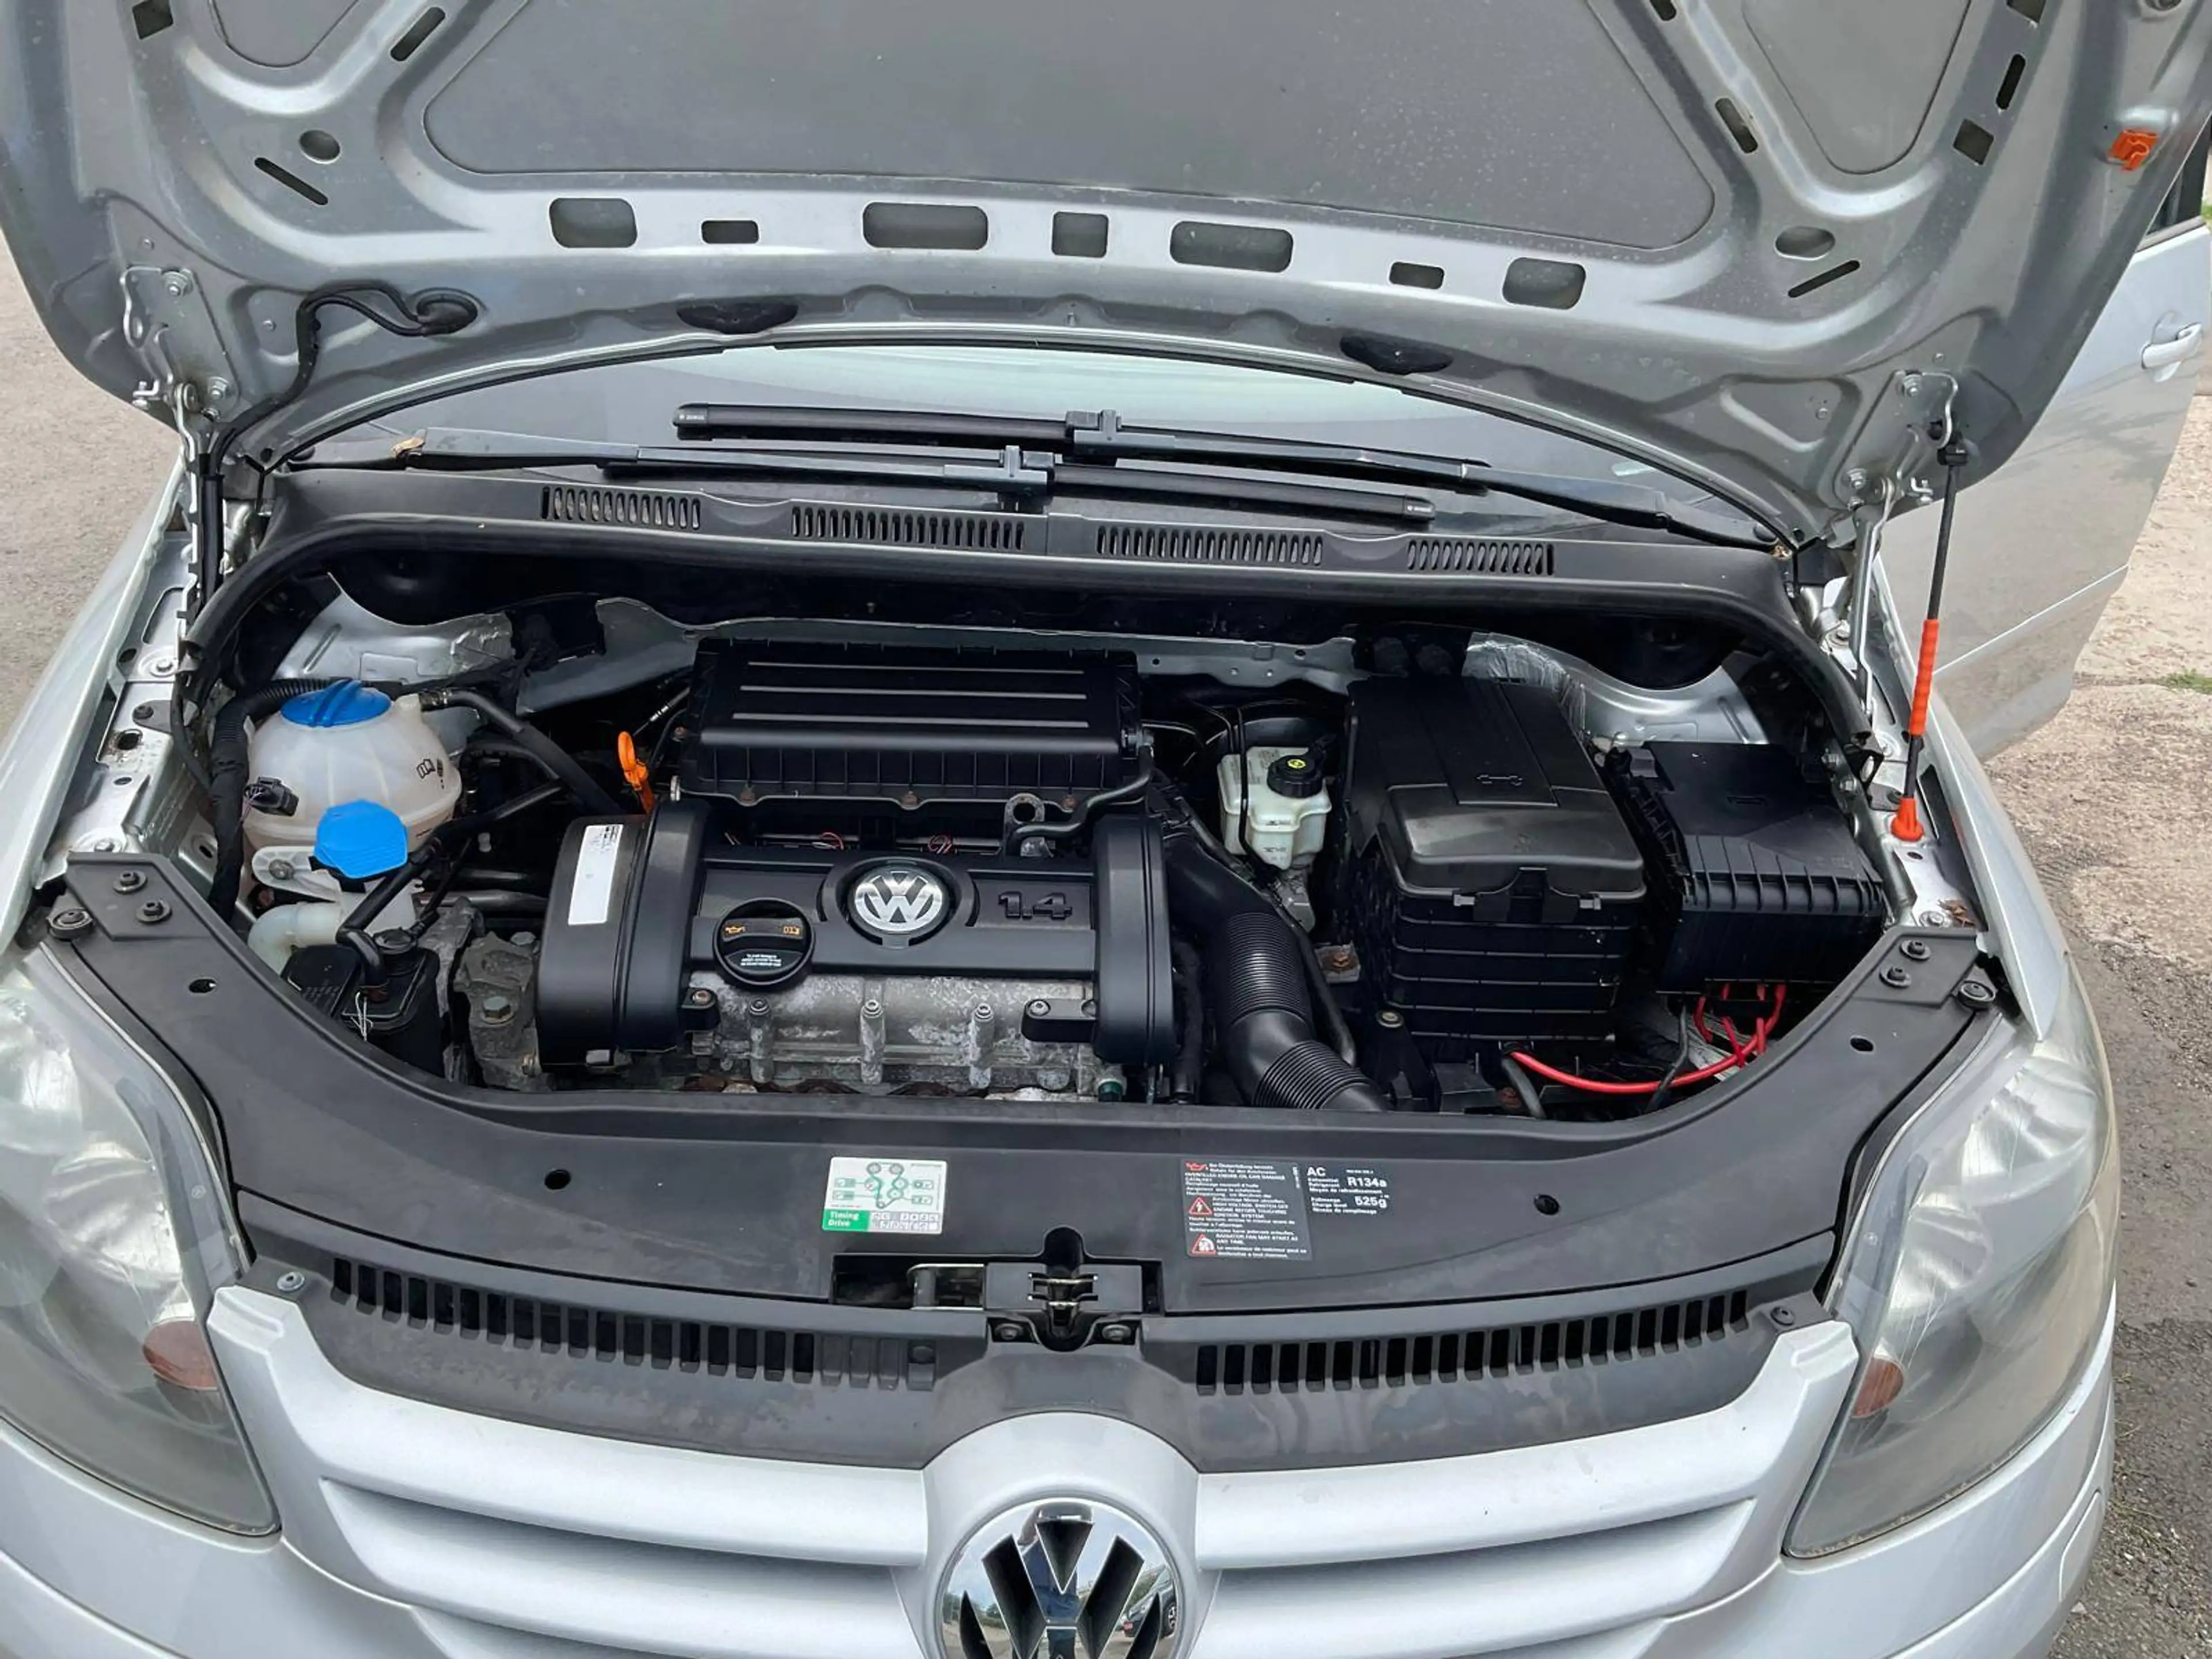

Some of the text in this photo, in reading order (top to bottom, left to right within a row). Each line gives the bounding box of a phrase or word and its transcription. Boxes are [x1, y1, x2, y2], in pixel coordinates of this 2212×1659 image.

[855, 870, 942, 932] VW
[998, 891, 1072, 920] 1.4
[1307, 1166, 1326, 1176] AC
[1347, 1176, 1387, 1187] R134a
[1354, 1195, 1387, 1209] 525g
